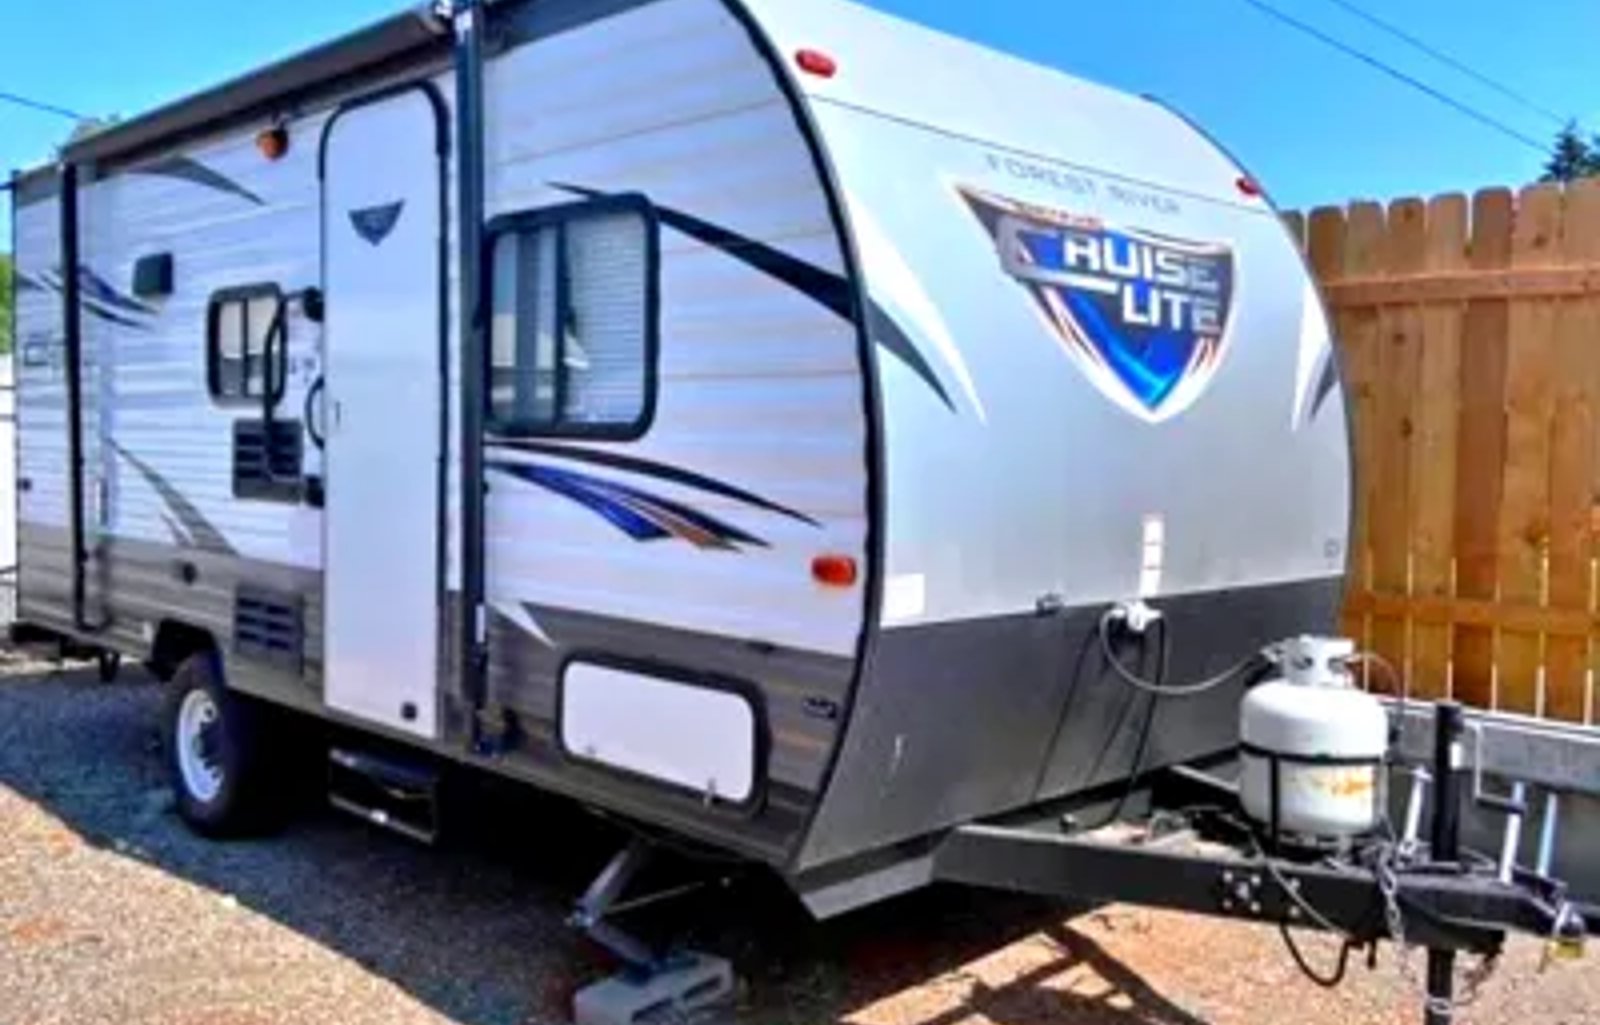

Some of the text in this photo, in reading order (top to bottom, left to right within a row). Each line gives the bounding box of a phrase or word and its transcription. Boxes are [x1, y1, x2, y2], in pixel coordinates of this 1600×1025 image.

[985, 152, 1097, 197] FOREST
[1105, 184, 1182, 216] RIVER
[996, 213, 1221, 295] CRUISE
[1121, 281, 1222, 337] LITE
